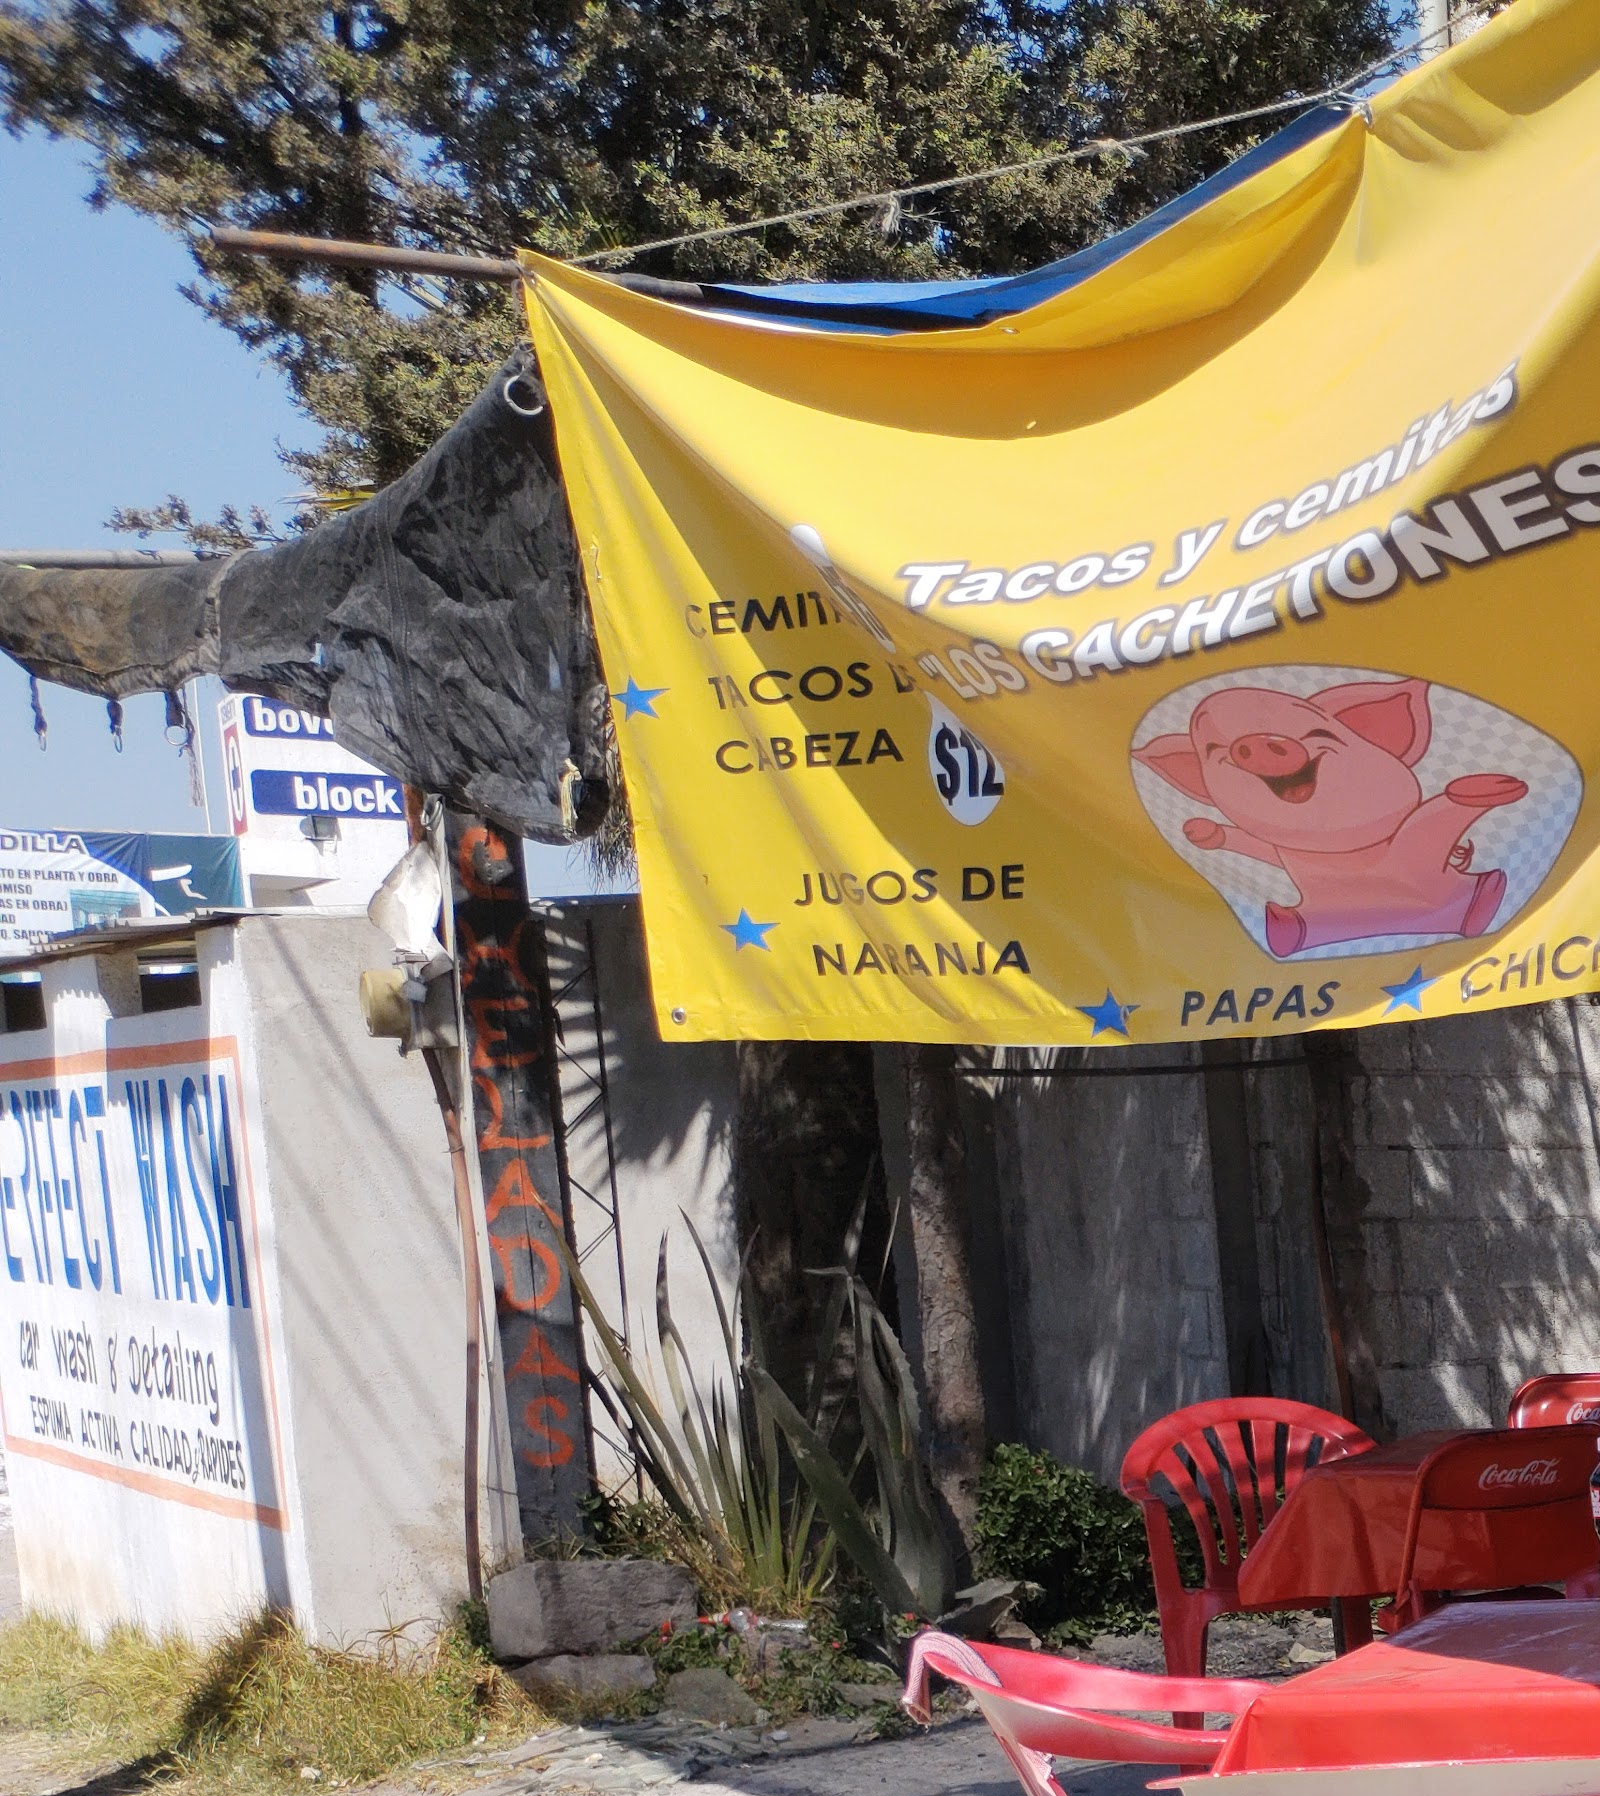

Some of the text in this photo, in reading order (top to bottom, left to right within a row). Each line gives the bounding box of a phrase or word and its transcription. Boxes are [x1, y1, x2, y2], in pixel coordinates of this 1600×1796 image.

[901, 545, 1151, 609] Tacos
[1174, 522, 1226, 580] y
[1238, 362, 1518, 550] cemitas
[708, 662, 873, 710] TACOS
[918, 642, 1027, 700] "LOS
[716, 722, 1004, 806] CABEZA $12
[295, 775, 402, 814] block
[794, 864, 1025, 906] JUGOS DE
[813, 941, 1031, 977] NARANJA
[1180, 981, 1340, 1027] PAPAS
[125, 1074, 251, 1309] WASH
[128, 1326, 220, 1427] Detailing
[30, 1395, 73, 1443] ESPUMA
[81, 1408, 123, 1459] ACTIVA
[1478, 1457, 1563, 1491] Coca-Cola
